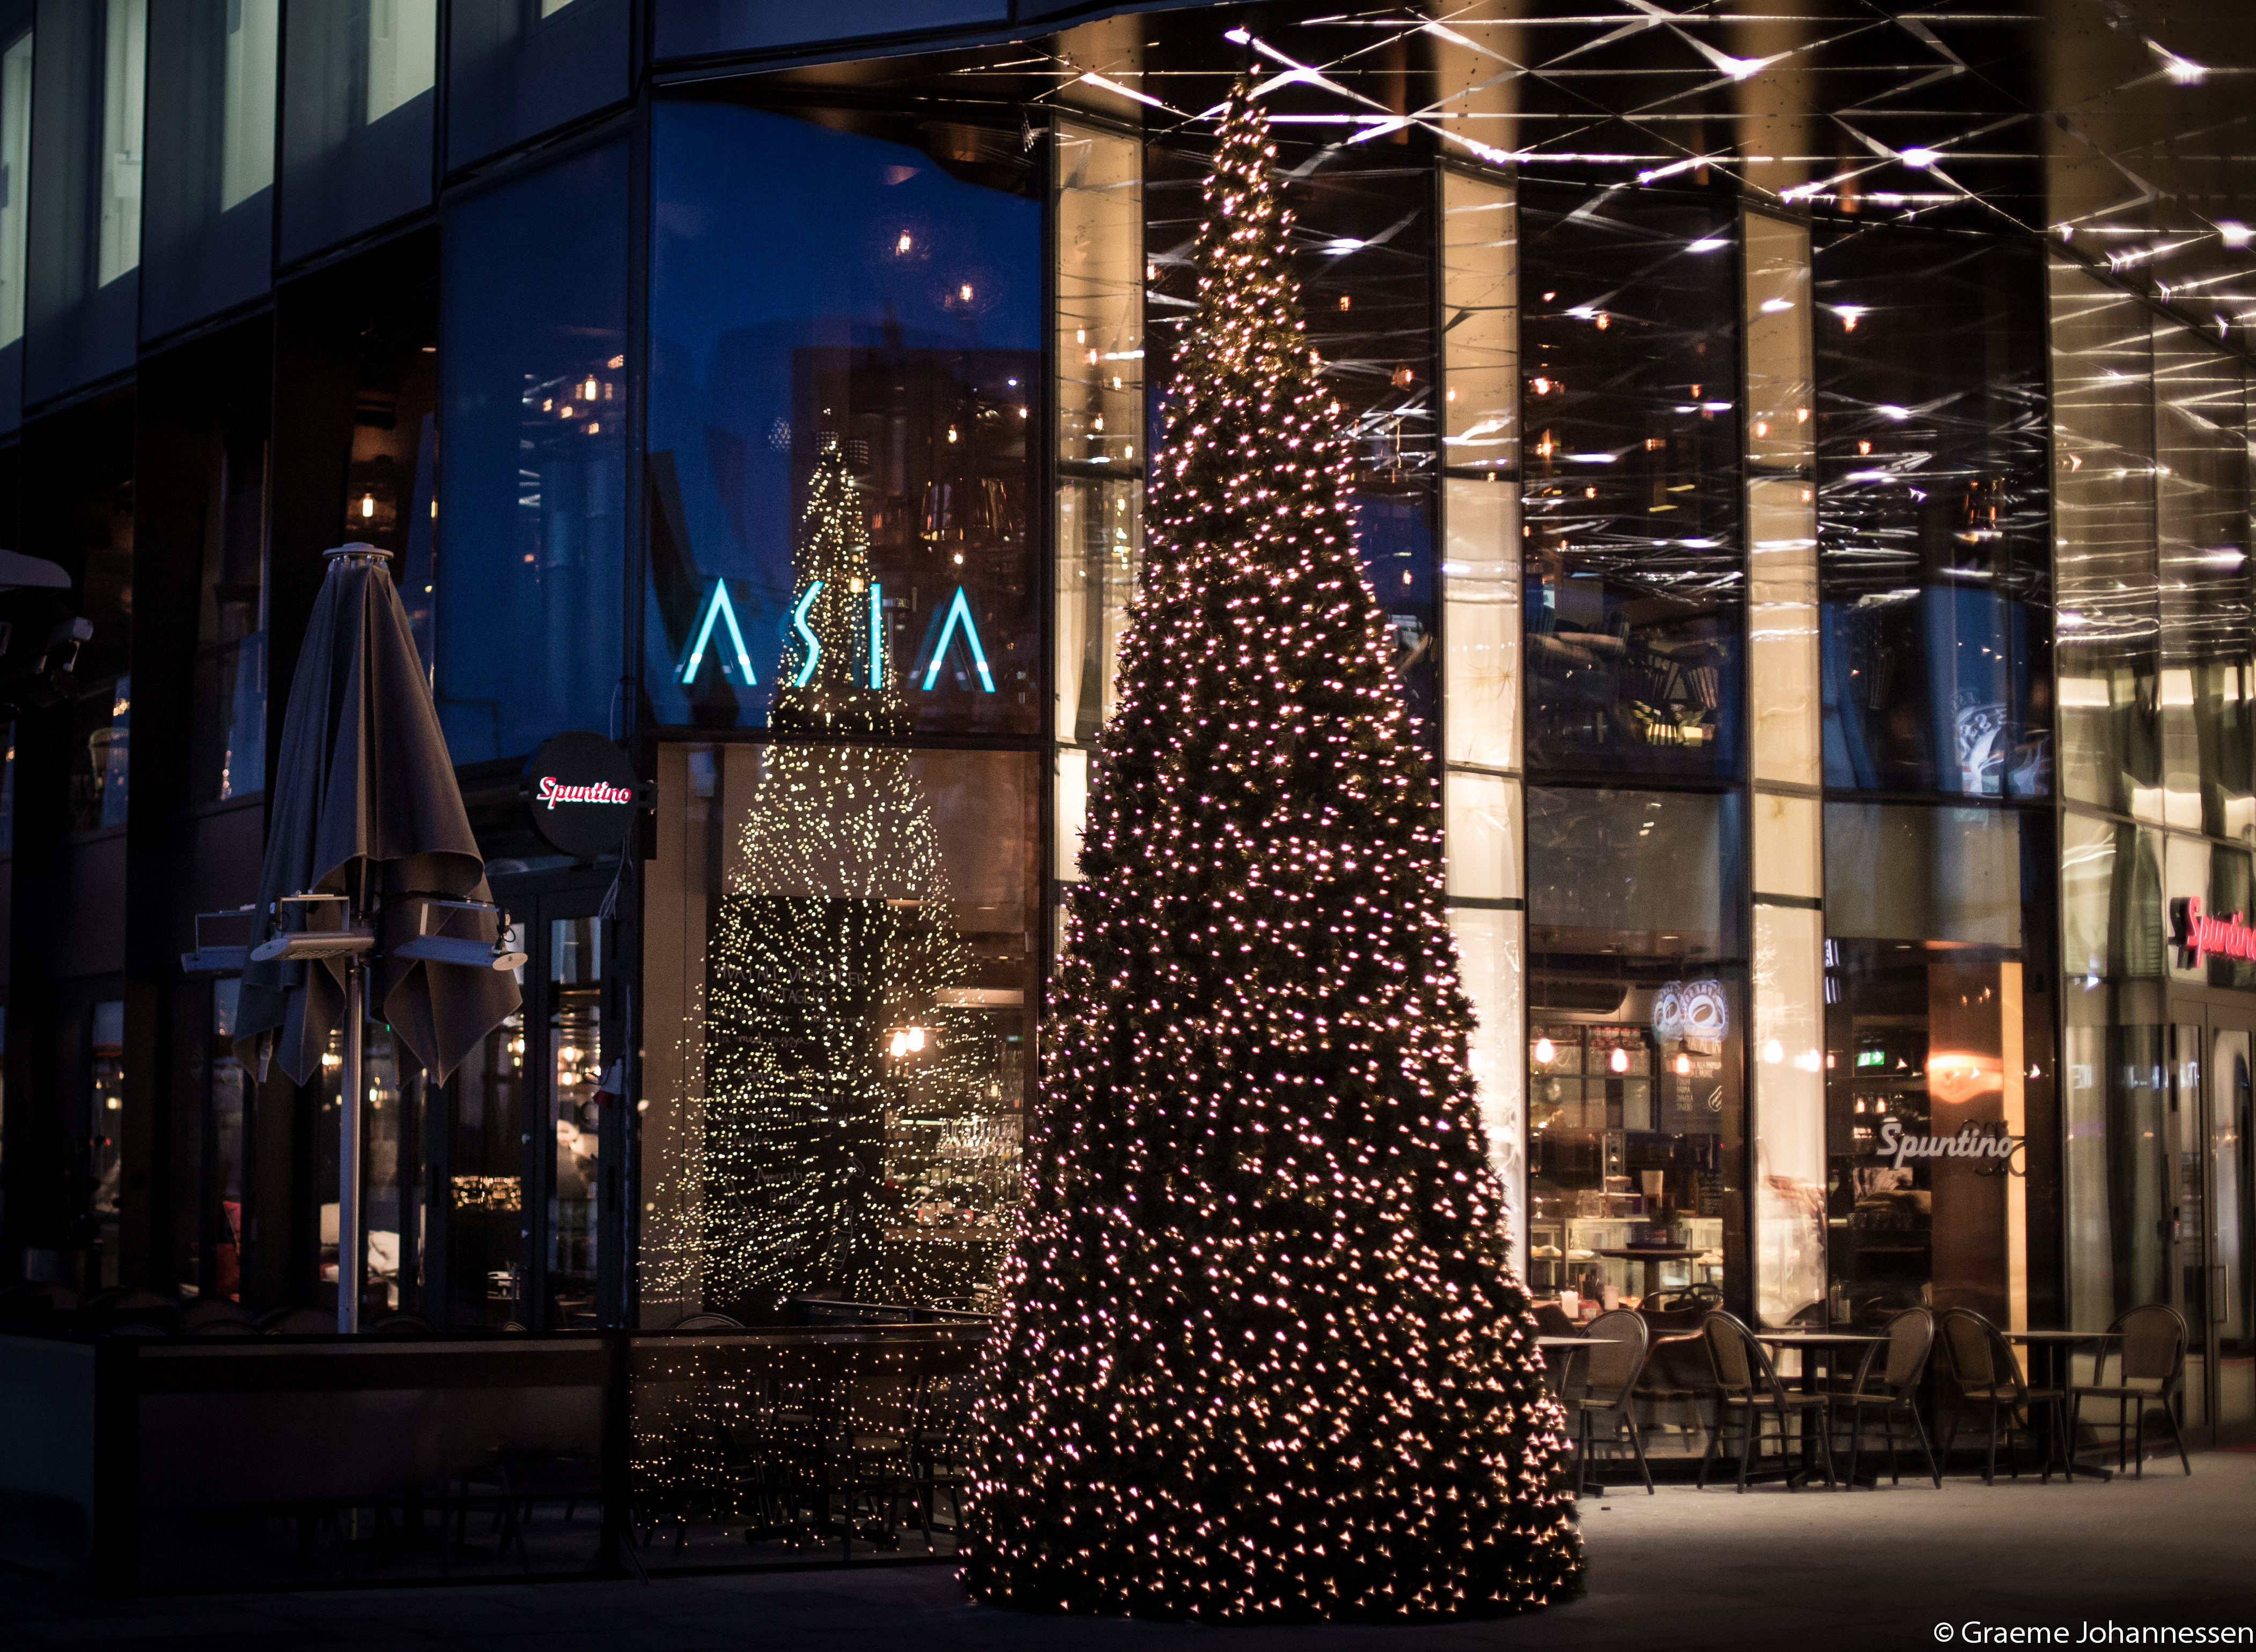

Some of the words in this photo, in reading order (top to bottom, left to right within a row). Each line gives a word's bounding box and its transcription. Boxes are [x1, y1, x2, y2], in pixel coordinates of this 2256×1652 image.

[683, 577, 996, 692] ASIA
[536, 777, 631, 810] Spuntino
[1877, 1123, 2012, 1170] Spuntino
